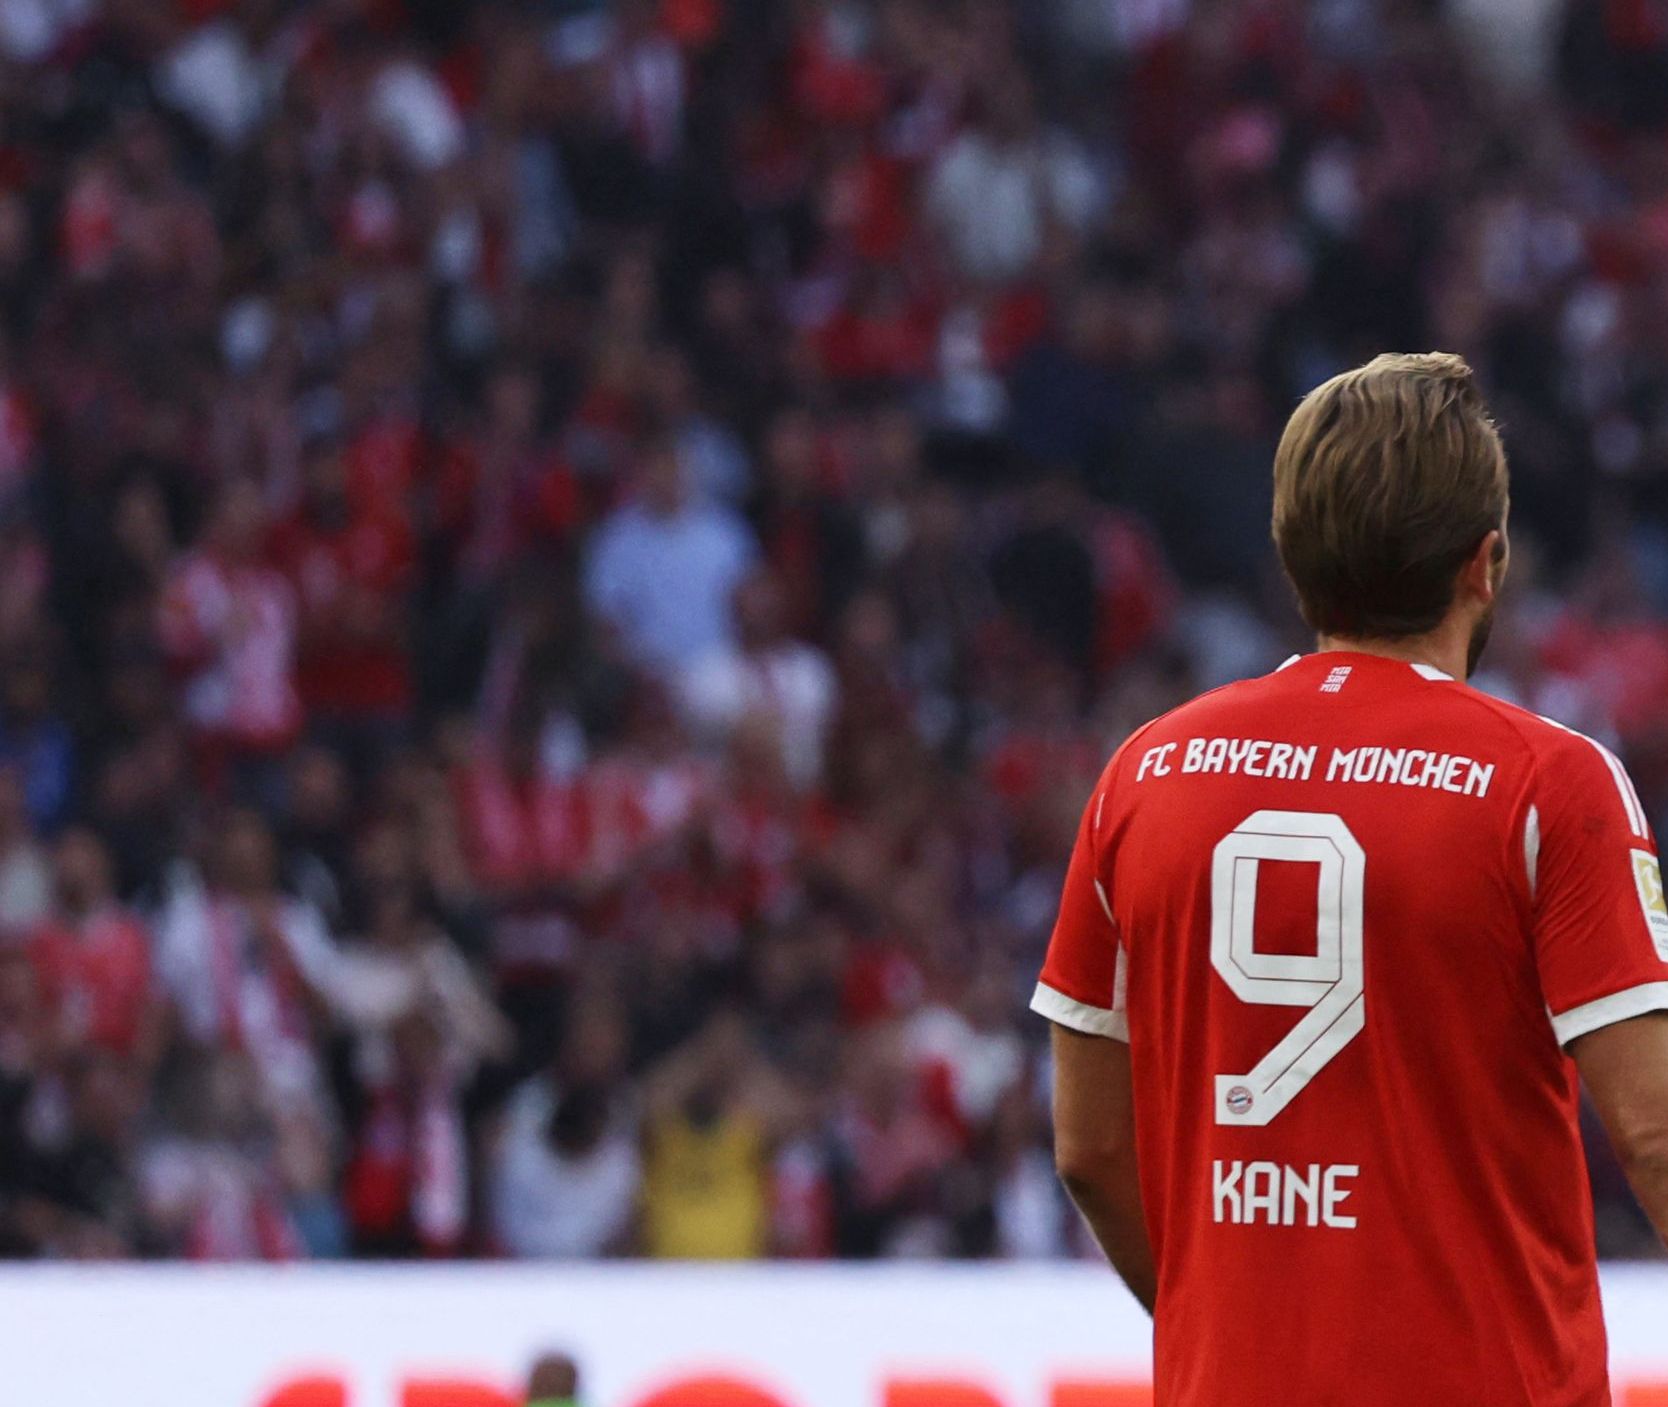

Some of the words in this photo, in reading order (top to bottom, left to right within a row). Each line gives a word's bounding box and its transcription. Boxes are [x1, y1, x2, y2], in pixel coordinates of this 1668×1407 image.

[1136, 742, 1178, 782] FC
[1181, 737, 1318, 781] BAYERN
[1325, 747, 1495, 798] MÜNCHEN
[1210, 809, 1366, 1126] 9
[1212, 1160, 1358, 1228] KANE
